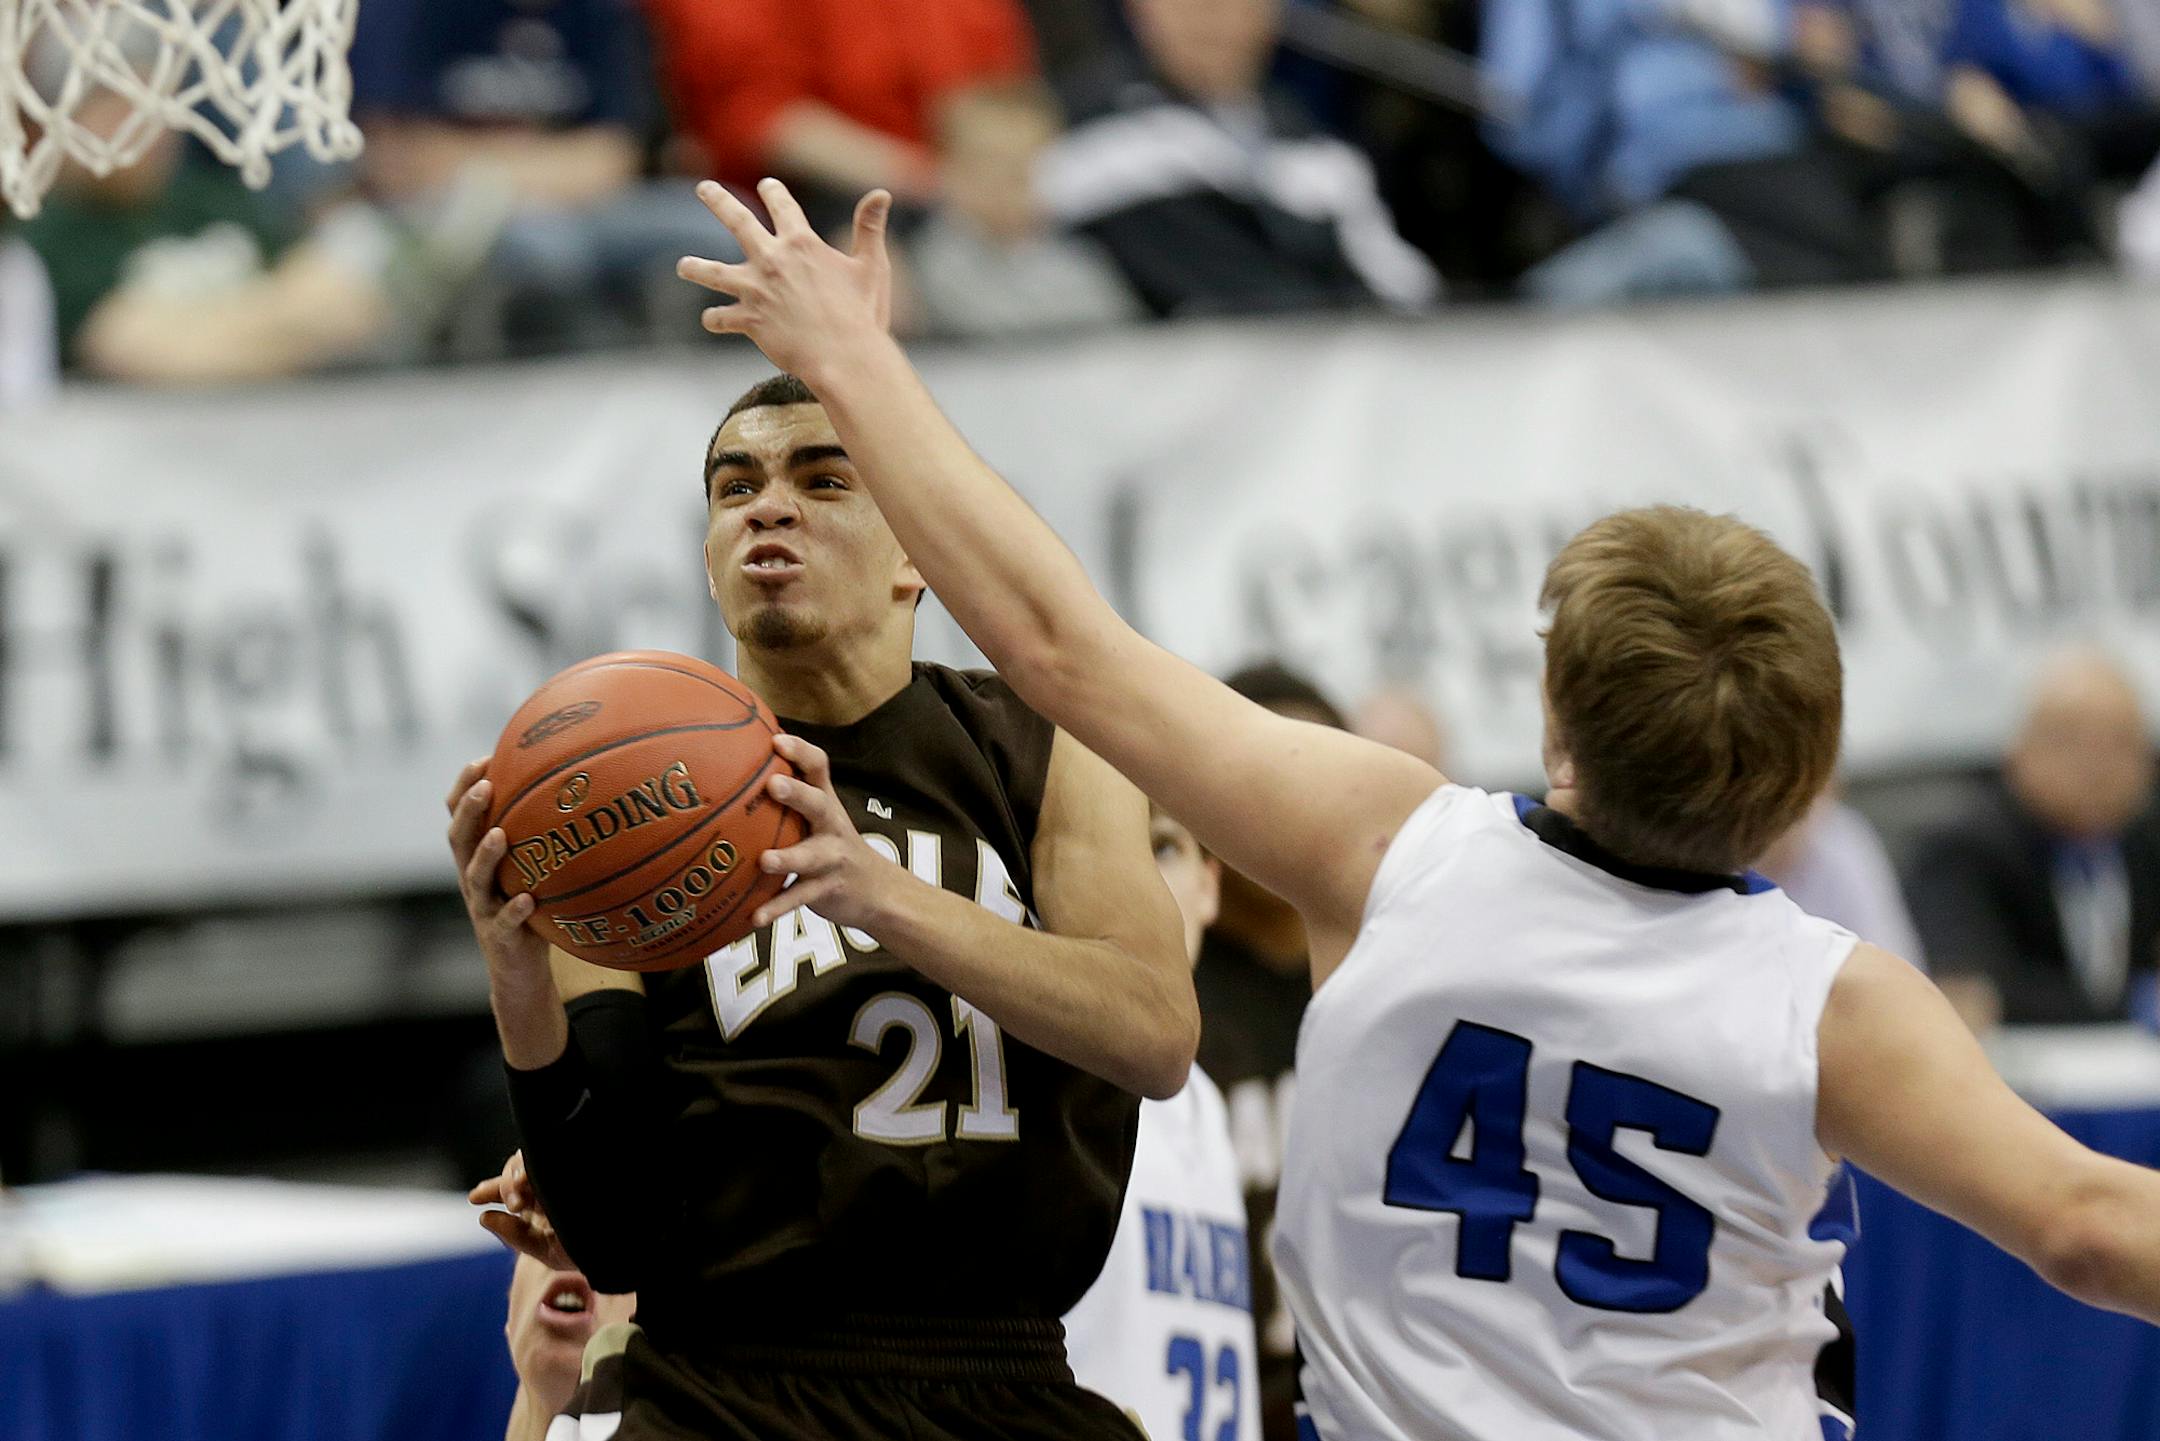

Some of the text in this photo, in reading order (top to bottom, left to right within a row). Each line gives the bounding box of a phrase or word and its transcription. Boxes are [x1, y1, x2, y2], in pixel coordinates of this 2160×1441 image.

[510, 760, 704, 891] SPALDING
[552, 840, 738, 944] TF-1000
[847, 991, 1019, 1145] 21
[1384, 1018, 1720, 1313] 45
